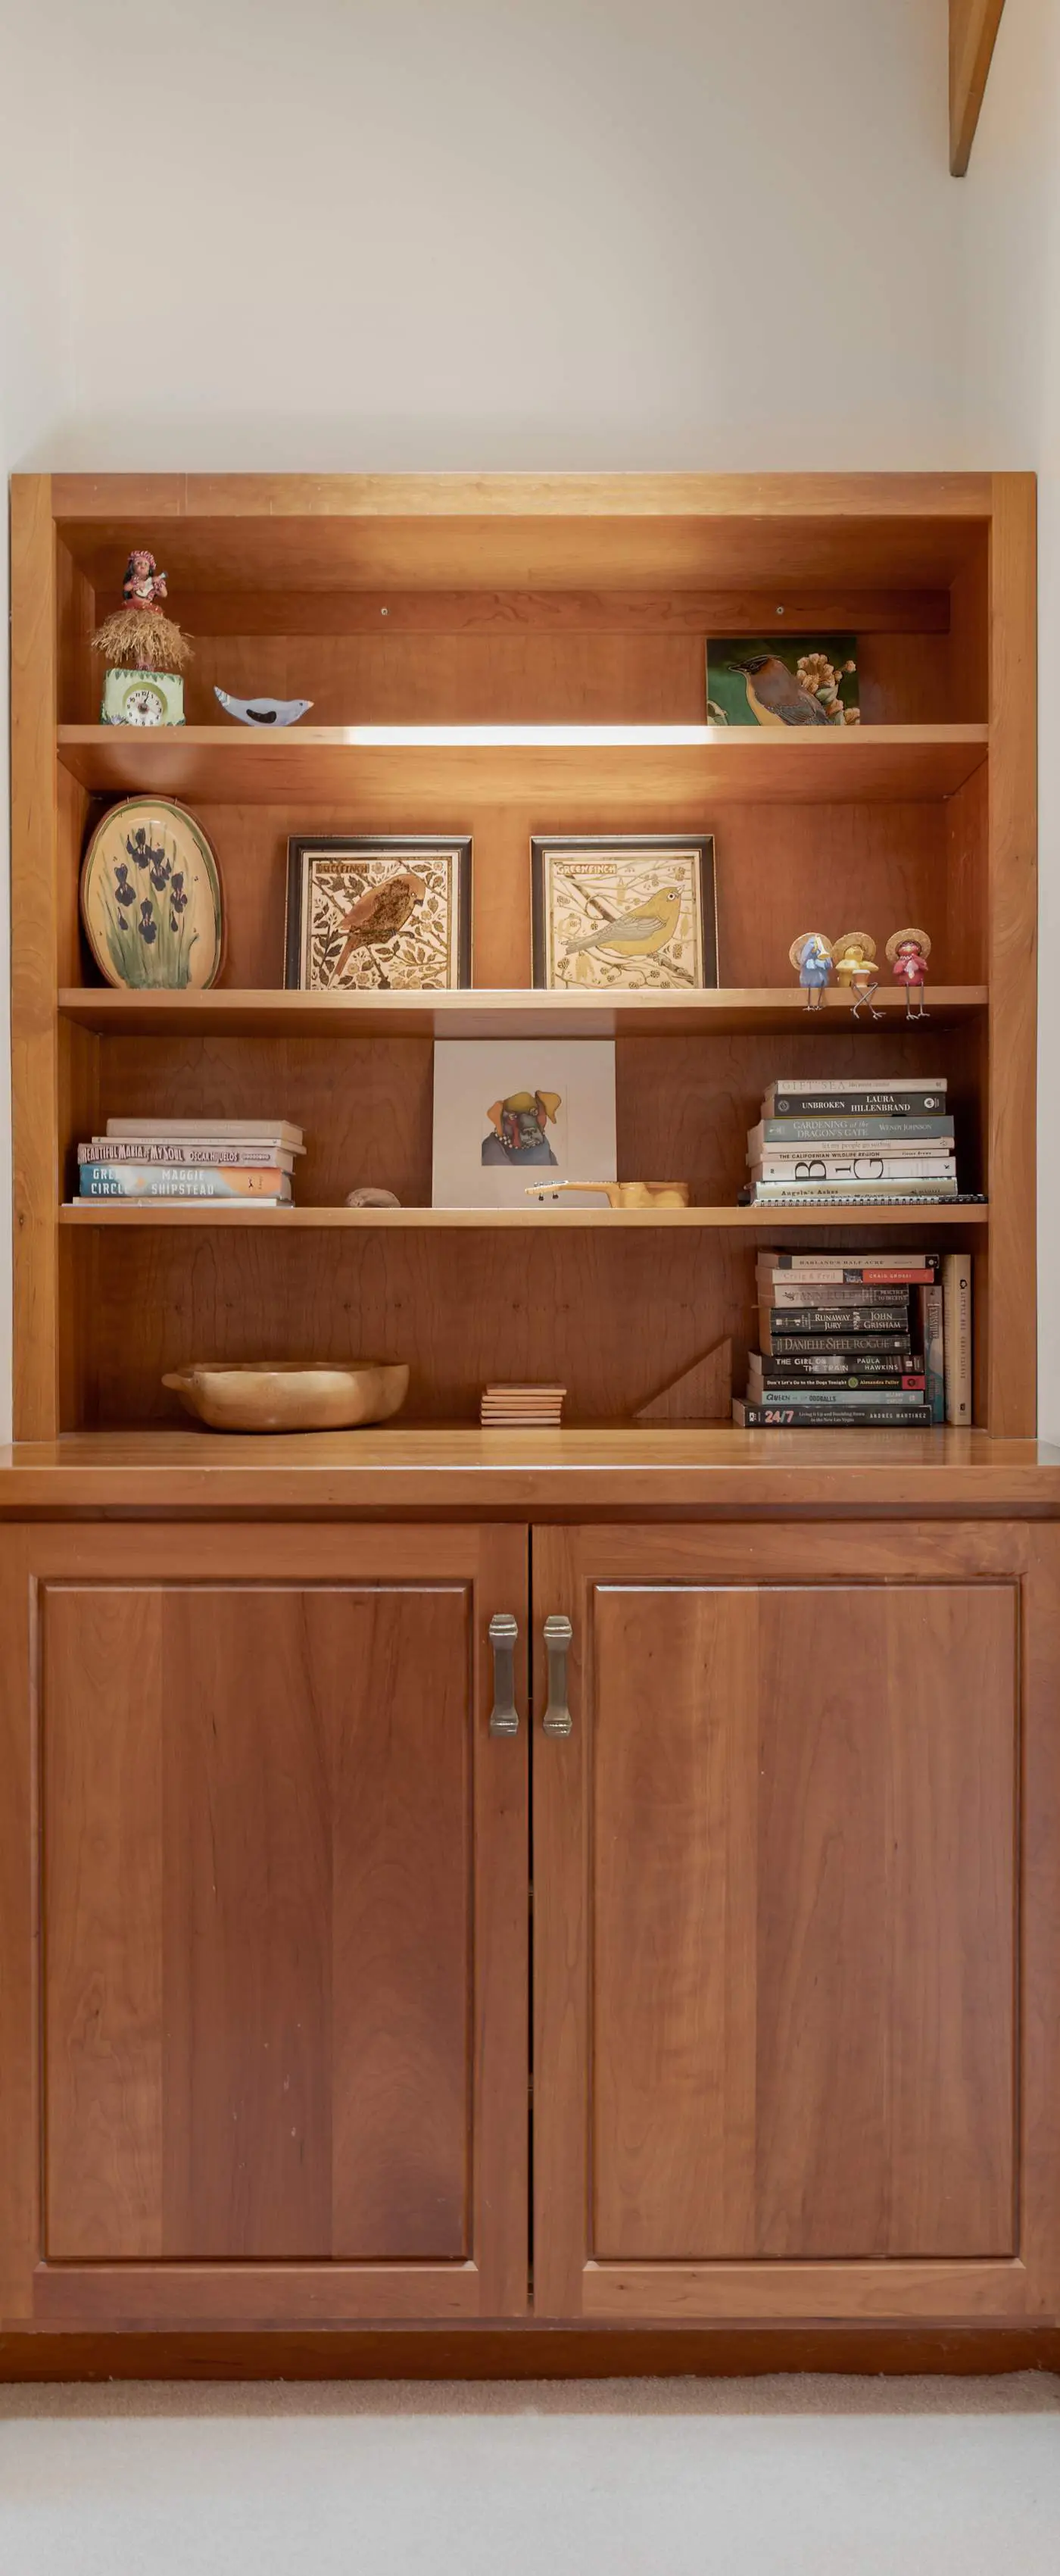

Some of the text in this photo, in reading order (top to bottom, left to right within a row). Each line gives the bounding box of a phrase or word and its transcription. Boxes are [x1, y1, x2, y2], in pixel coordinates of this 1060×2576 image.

[851, 1104, 911, 1112] HILLENBRAND
[793, 1120, 847, 1129] GARDENING
[797, 1129, 843, 1139] DRAGON'S
[841, 1141, 861, 1150] people
[119, 1144, 144, 1160] MARIA
[163, 1146, 185, 1162] SOUL
[189, 1151, 210, 1161] OSCAR
[210, 1152, 239, 1163] HIJUELOS
[162, 1169, 204, 1181] MAGGIE
[151, 1183, 214, 1195] SHIPSTEAD
[781, 1188, 813, 1197] Angela's
[815, 1313, 850, 1322] RUNAWAY
[871, 1311, 893, 1321] JOHN
[825, 1322, 841, 1331] JURY
[863, 1320, 901, 1329] GRISHAM
[784, 1337, 851, 1350] DANIELLE STEEL
[853, 1339, 890, 1349] ROGUE
[803, 1364, 849, 1372] THE TRAIN
[765, 1410, 794, 1423] 24/7
